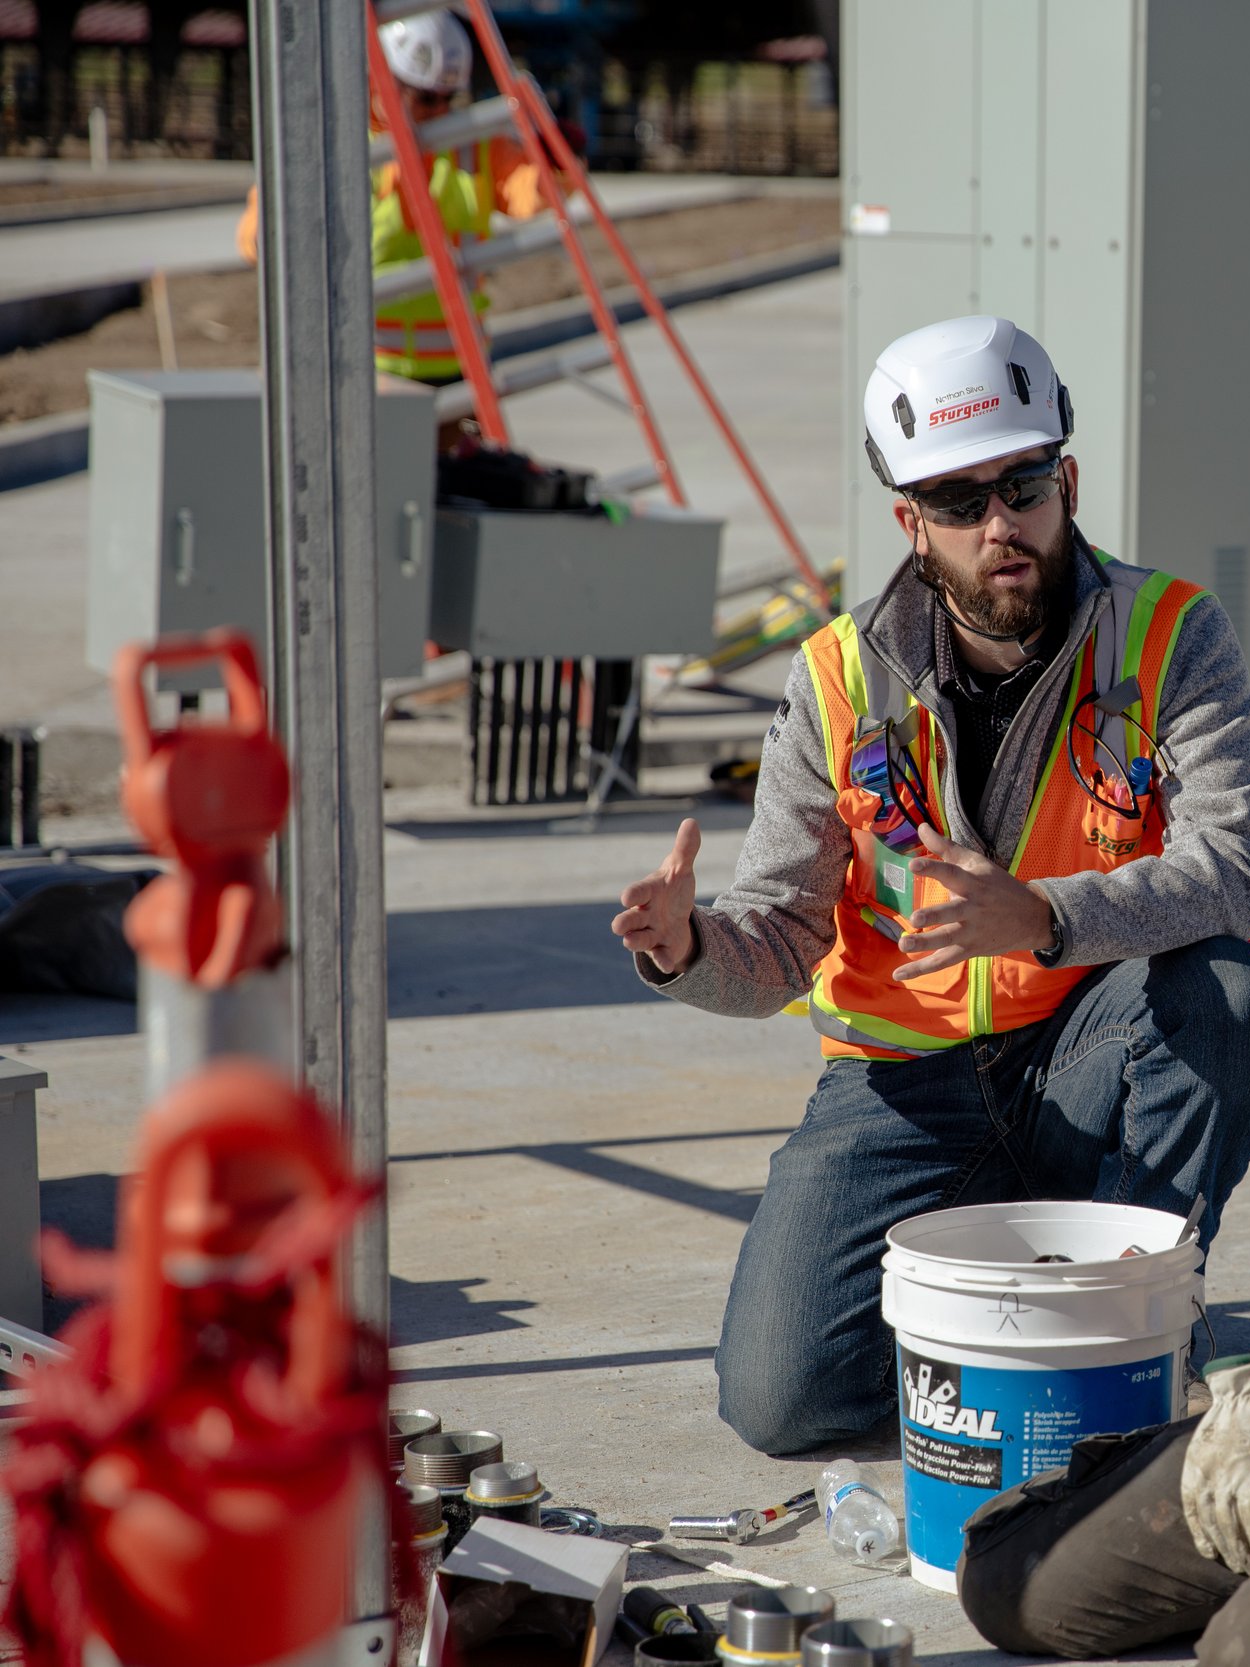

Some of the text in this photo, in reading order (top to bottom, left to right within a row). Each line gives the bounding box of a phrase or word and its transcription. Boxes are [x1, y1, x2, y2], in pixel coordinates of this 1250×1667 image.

[965, 385, 984, 395] Silva
[929, 397, 1000, 427] Sturgeon
[909, 1387, 1003, 1441] IDEAL
[929, 1441, 943, 1452] Pull
[943, 1445, 960, 1456] Line
[924, 1463, 948, 1478] traction
